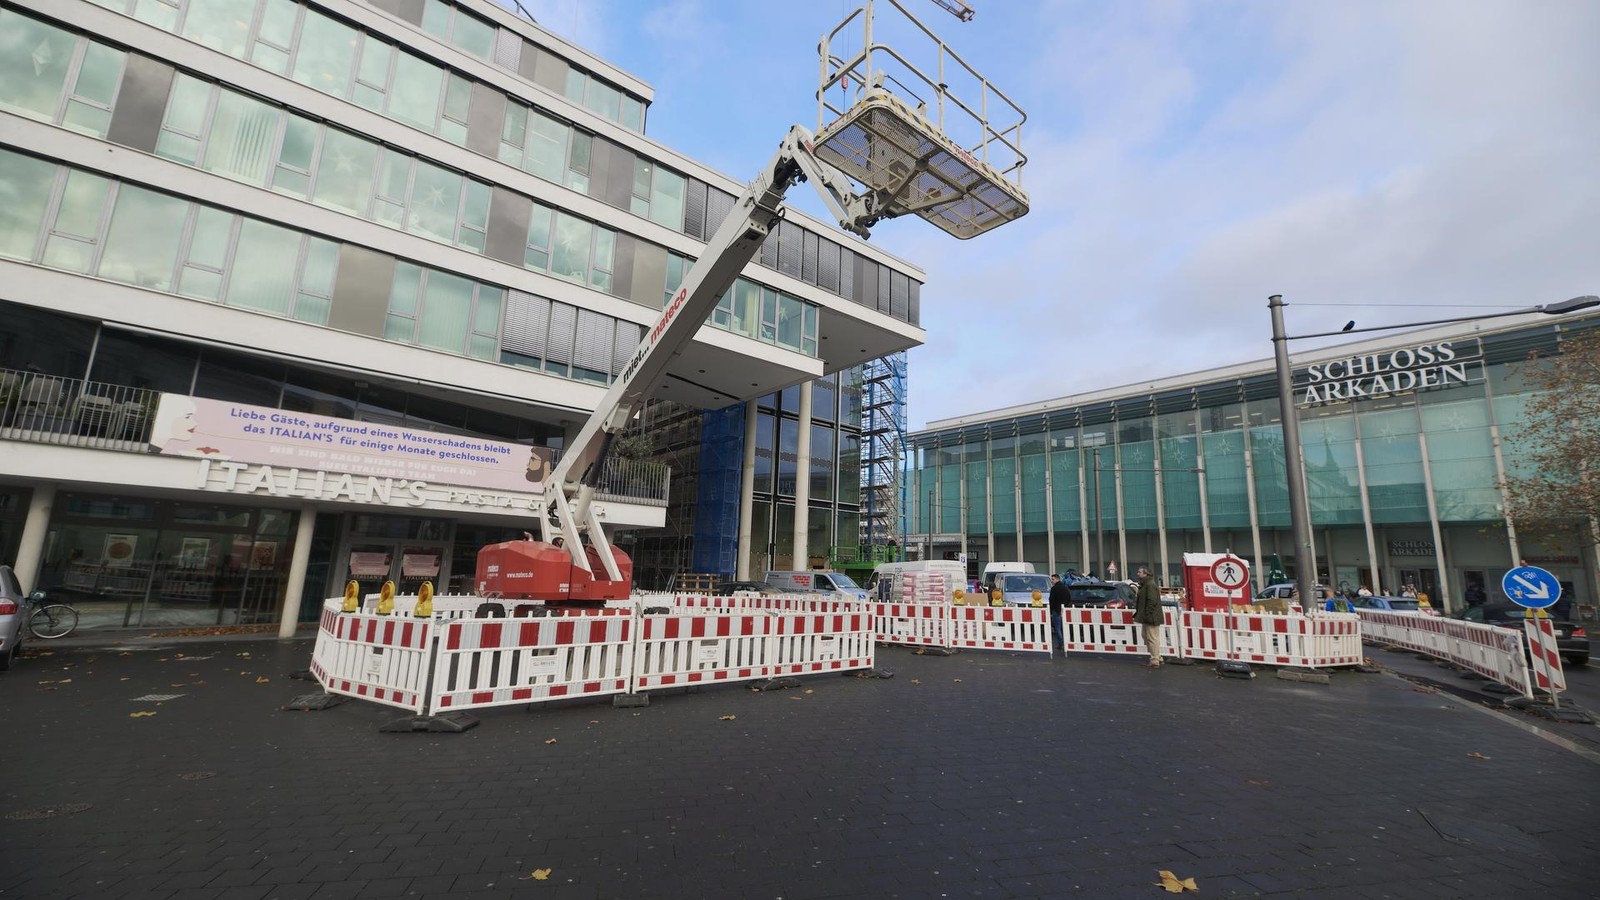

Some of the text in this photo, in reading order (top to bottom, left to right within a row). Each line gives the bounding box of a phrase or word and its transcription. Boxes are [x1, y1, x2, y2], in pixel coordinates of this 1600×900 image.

[650, 287, 688, 345] mateco
[1303, 361, 1468, 404] ARKADEN
[1307, 341, 1456, 383] SCHLOSS
[230, 407, 511, 455] Liebe Gäste, aufgrund eines Wasserschadens bleibt
[243, 424, 499, 465] das ITALIAN'S für einige Monate geschlossen.
[297, 448, 327, 459] SIND
[330, 452, 361, 463] BALD
[364, 456, 405, 468] WIEDER
[408, 469, 436, 480] TEAM
[197, 459, 540, 511] ITALIAN'S PASTA &
[1391, 548, 1435, 556] ARKADE
